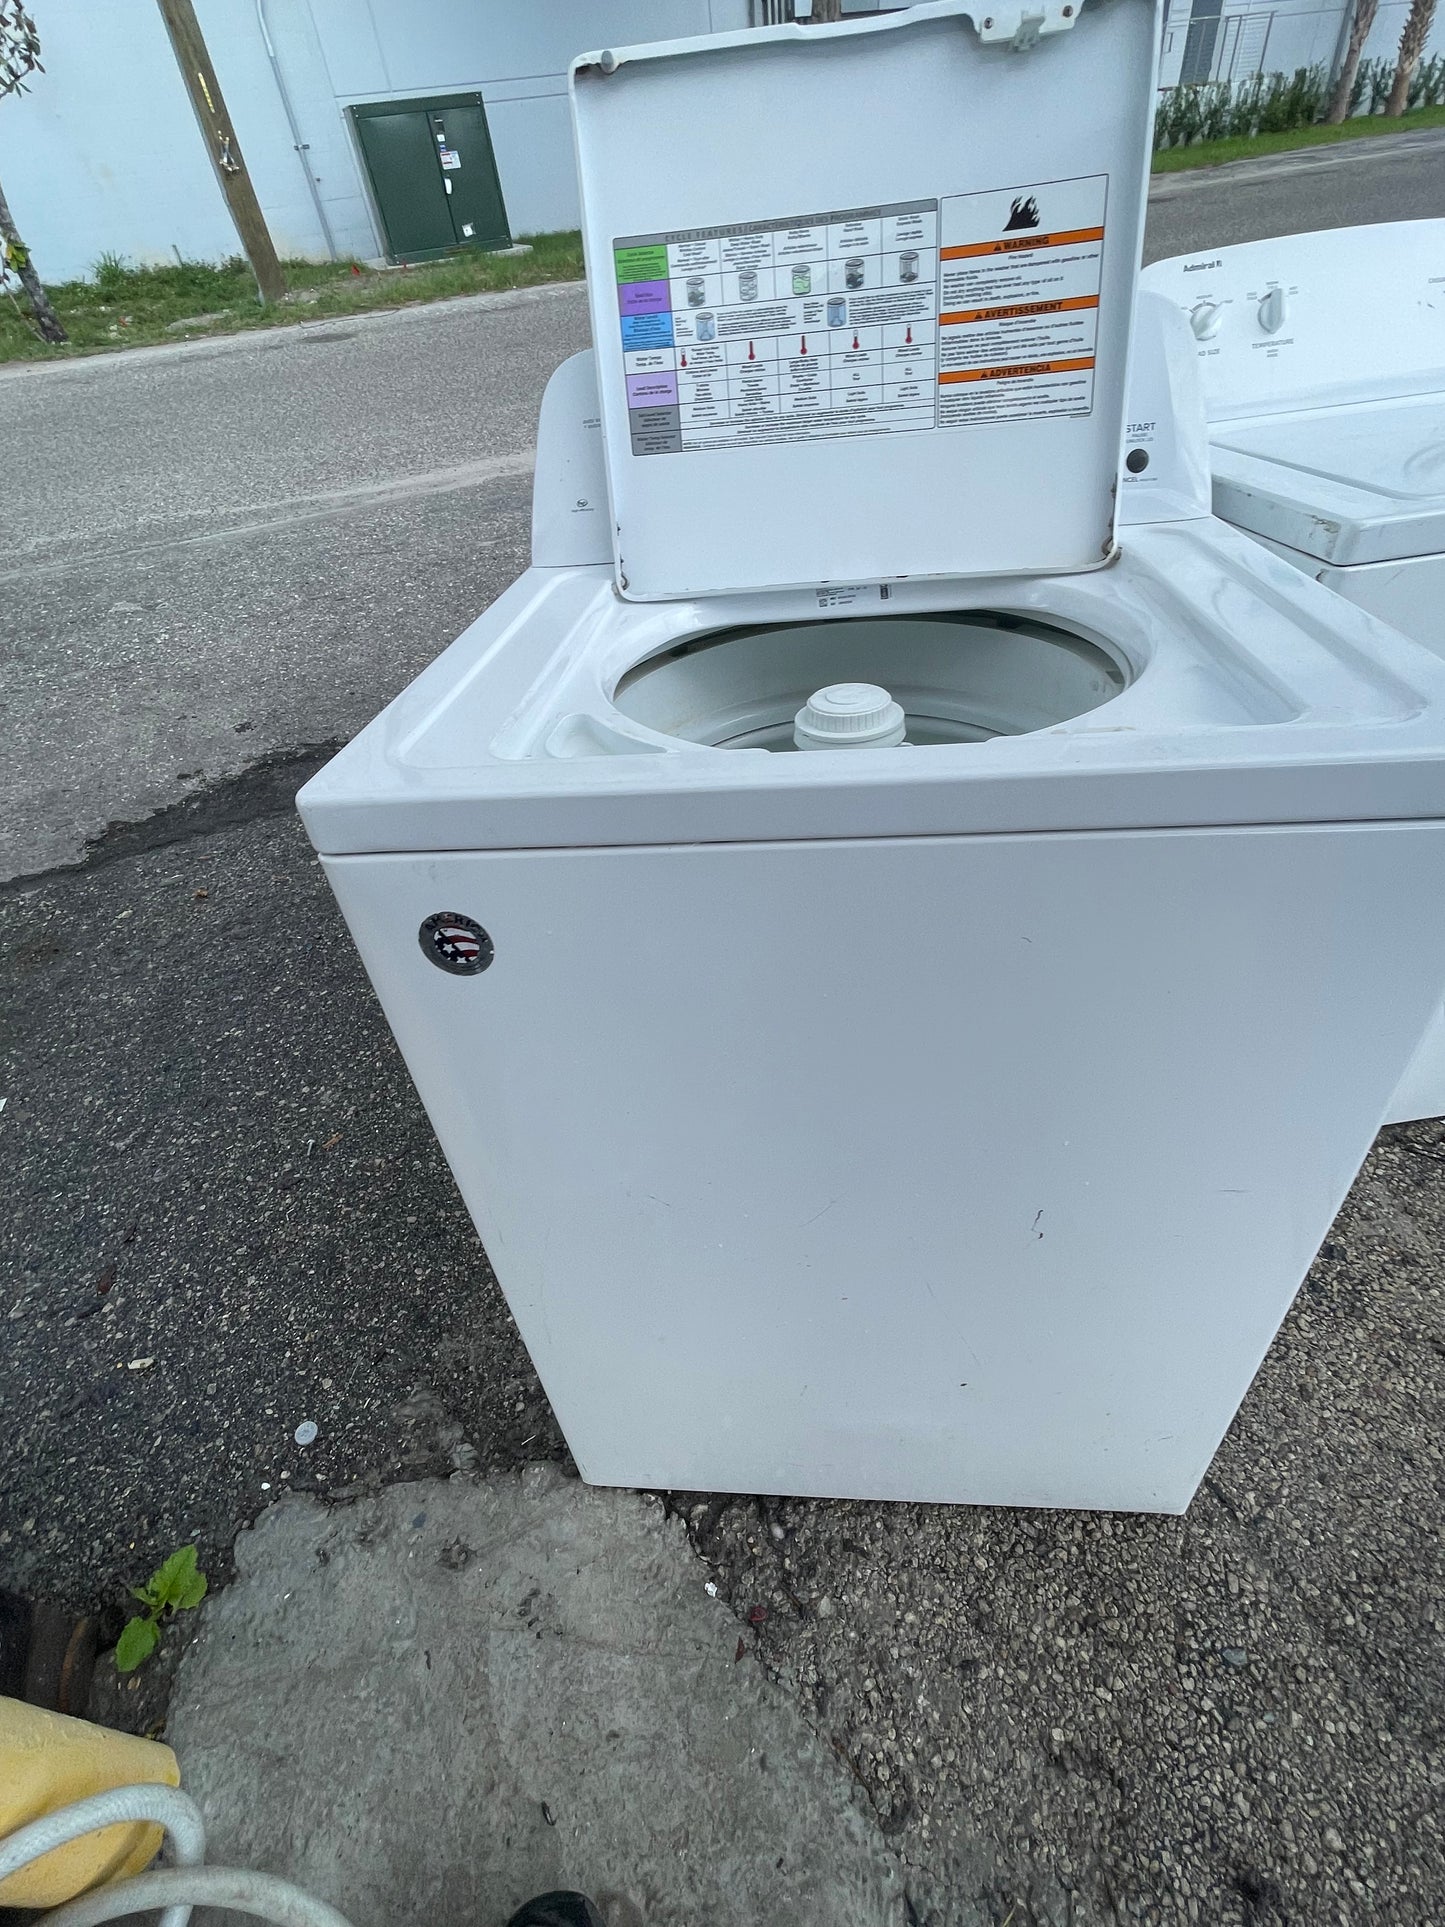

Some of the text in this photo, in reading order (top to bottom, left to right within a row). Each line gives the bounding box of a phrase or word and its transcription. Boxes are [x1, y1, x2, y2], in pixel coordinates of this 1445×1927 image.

[665, 233, 692, 242] CYCLE
[1003, 236, 1049, 250] WARNING
[1183, 261, 1215, 273] Admiral
[984, 302, 1064, 319] AVERTISSEMENT
[1252, 338, 1294, 349] TEMPERATURE
[989, 364, 1052, 377] ADVERTENCIA
[1126, 422, 1156, 433] START
